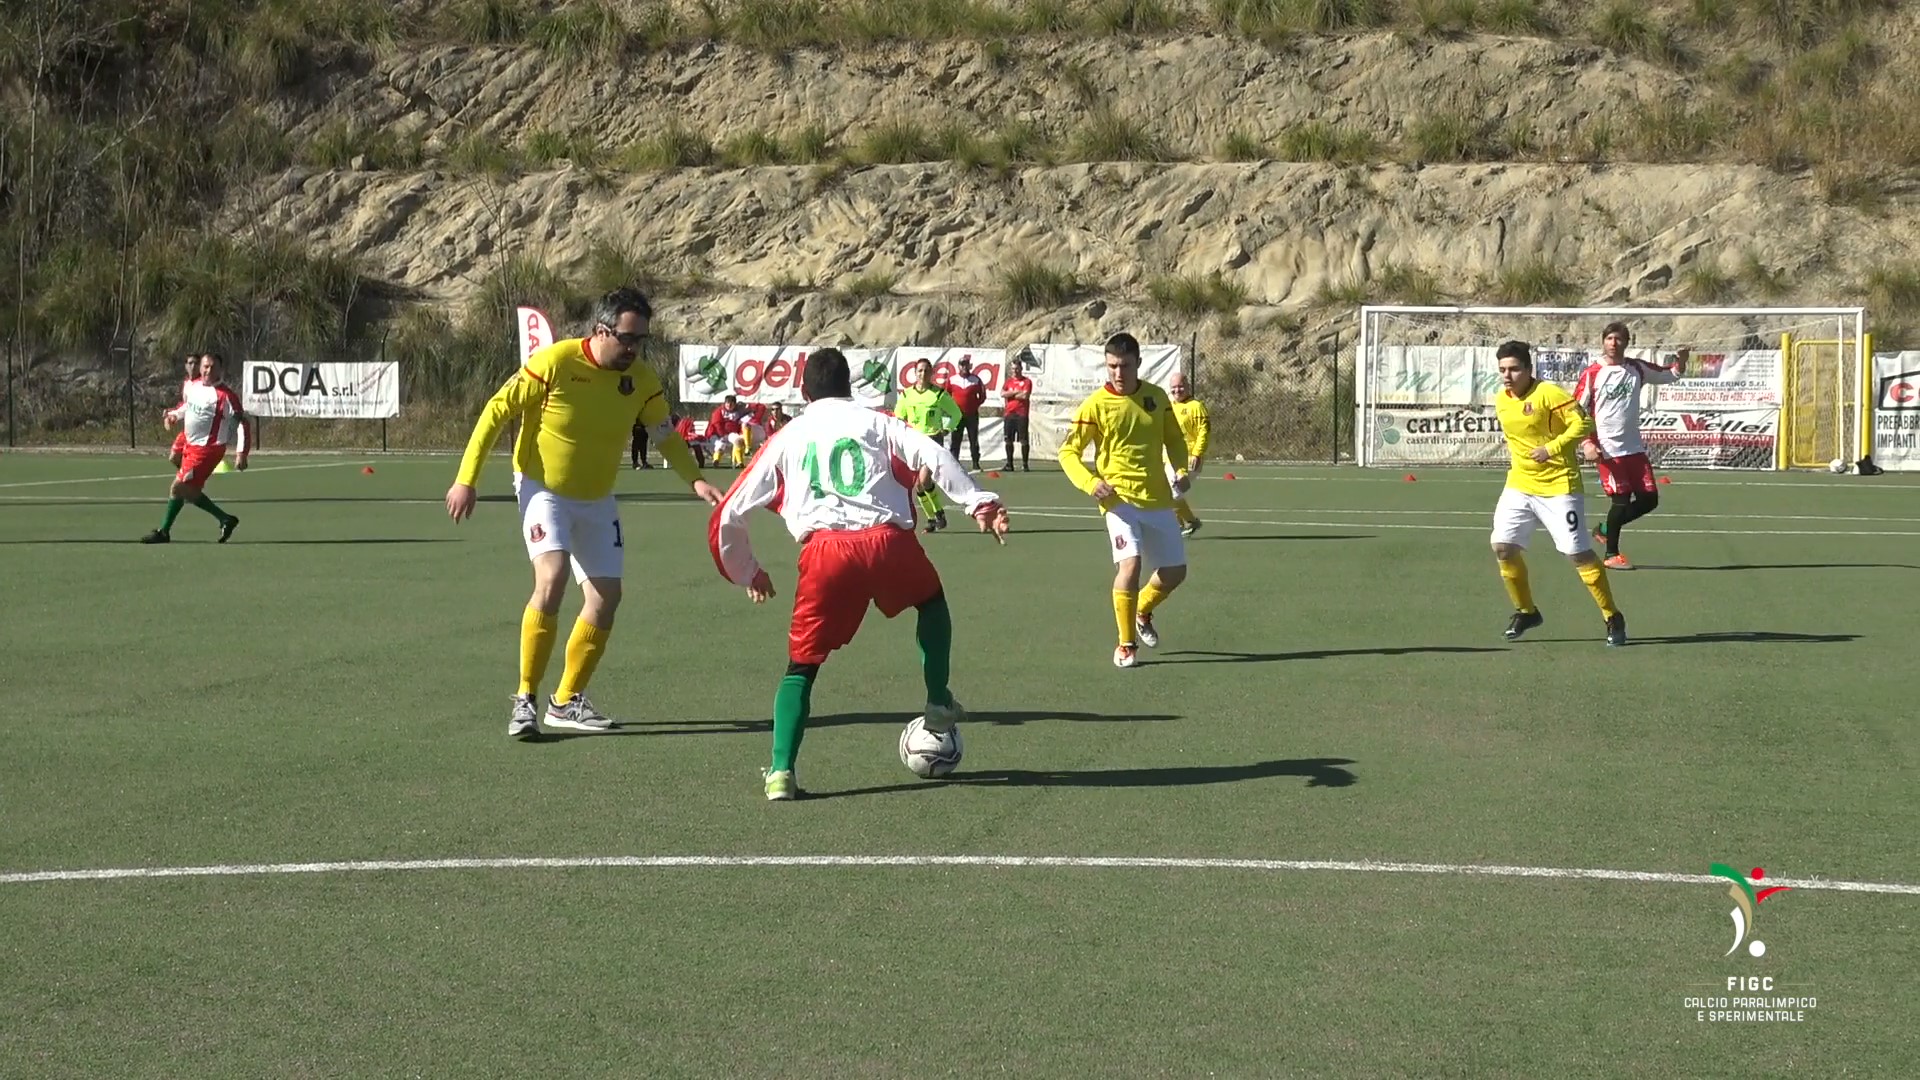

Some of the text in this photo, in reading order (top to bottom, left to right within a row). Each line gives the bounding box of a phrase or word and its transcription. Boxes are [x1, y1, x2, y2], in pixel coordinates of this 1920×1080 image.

[252, 365, 357, 397] DCA s.r.l.
[734, 352, 807, 397] get
[1688, 380, 1747, 388] ENGINEERING
[1640, 413, 1773, 434] ria Vellei
[1406, 436, 1429, 445] cassa
[1430, 434, 1440, 445] di
[1441, 435, 1485, 446] risparmio
[1667, 433, 1721, 441] COMPOSITI
[1877, 433, 1917, 449] IMPIANTI
[801, 436, 867, 499] 10
[1566, 510, 1578, 532] 9
